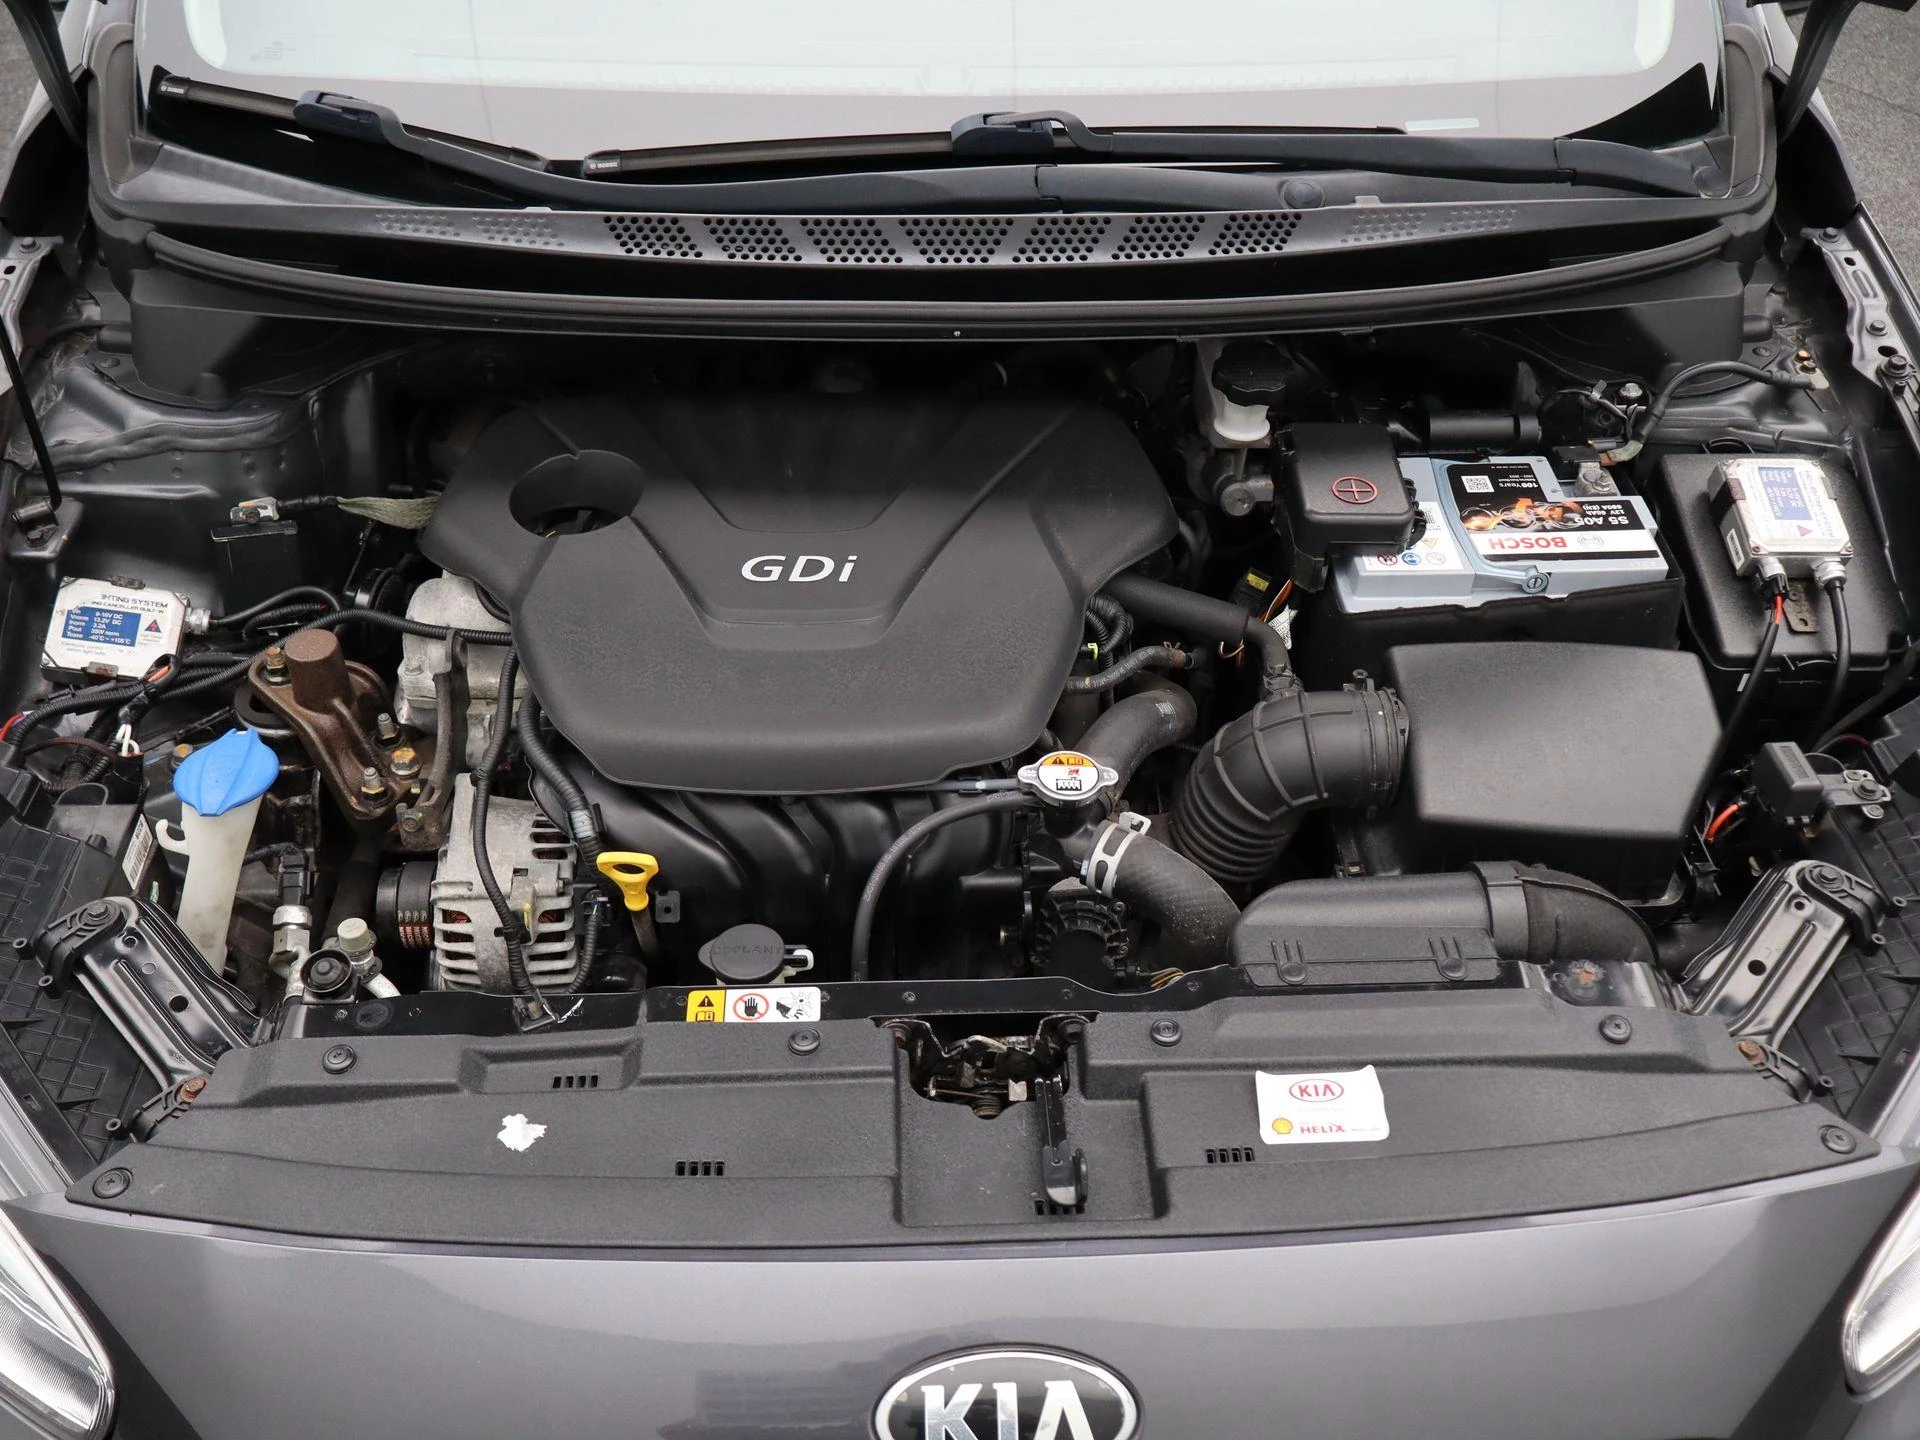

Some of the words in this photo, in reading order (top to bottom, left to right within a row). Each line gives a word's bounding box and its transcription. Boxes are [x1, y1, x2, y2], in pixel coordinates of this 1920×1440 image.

[1574, 516, 1603, 525] A05
[1608, 516, 1629, 525] S5
[1488, 537, 1568, 550] BOSCH
[741, 555, 858, 582] GDi
[131, 598, 168, 608] SYSTEM
[712, 944, 783, 955] COOLANT
[1298, 1084, 1335, 1097] KIA
[1300, 1124, 1345, 1133] HELIX
[921, 1380, 1095, 1440] KIA
